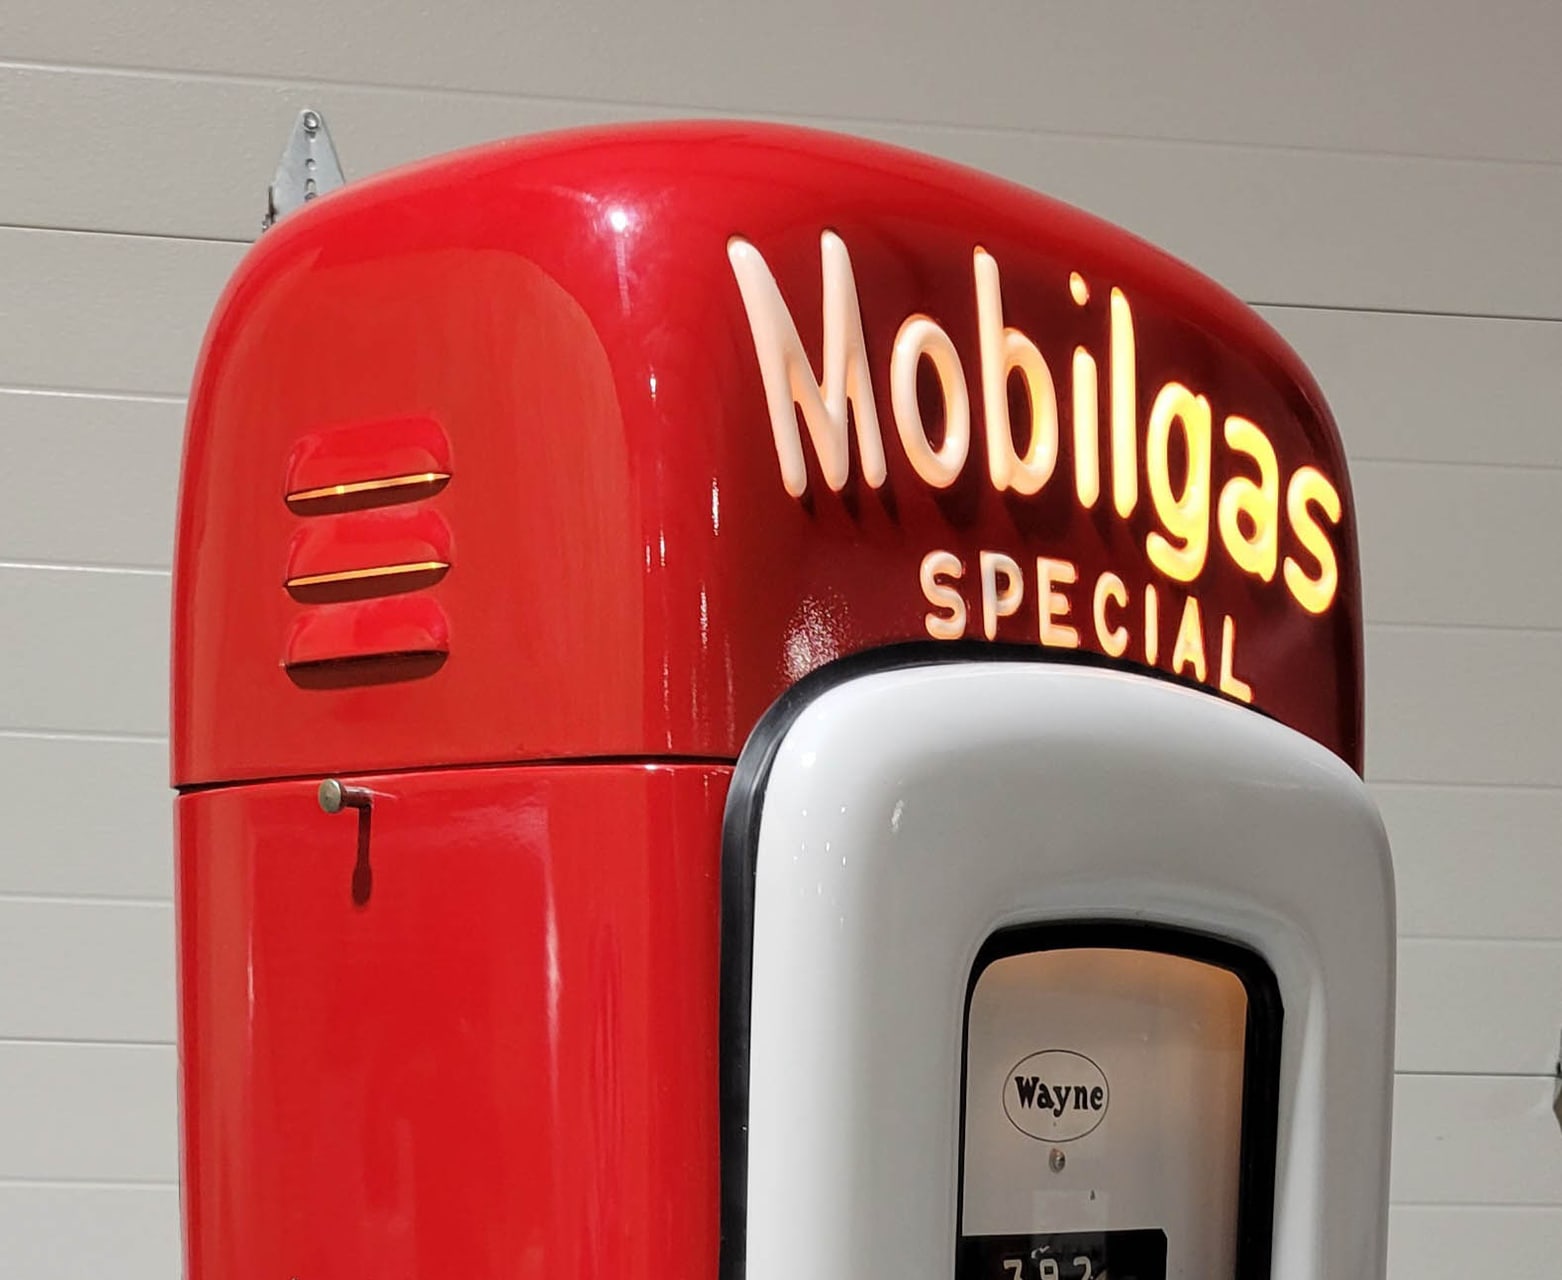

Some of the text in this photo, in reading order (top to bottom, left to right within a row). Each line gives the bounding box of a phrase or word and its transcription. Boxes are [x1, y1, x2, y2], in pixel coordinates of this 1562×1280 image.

[727, 229, 1341, 614] Mobilgas
[920, 550, 1254, 702] SPECIAL
[1014, 1076, 1104, 1117] Wayne
